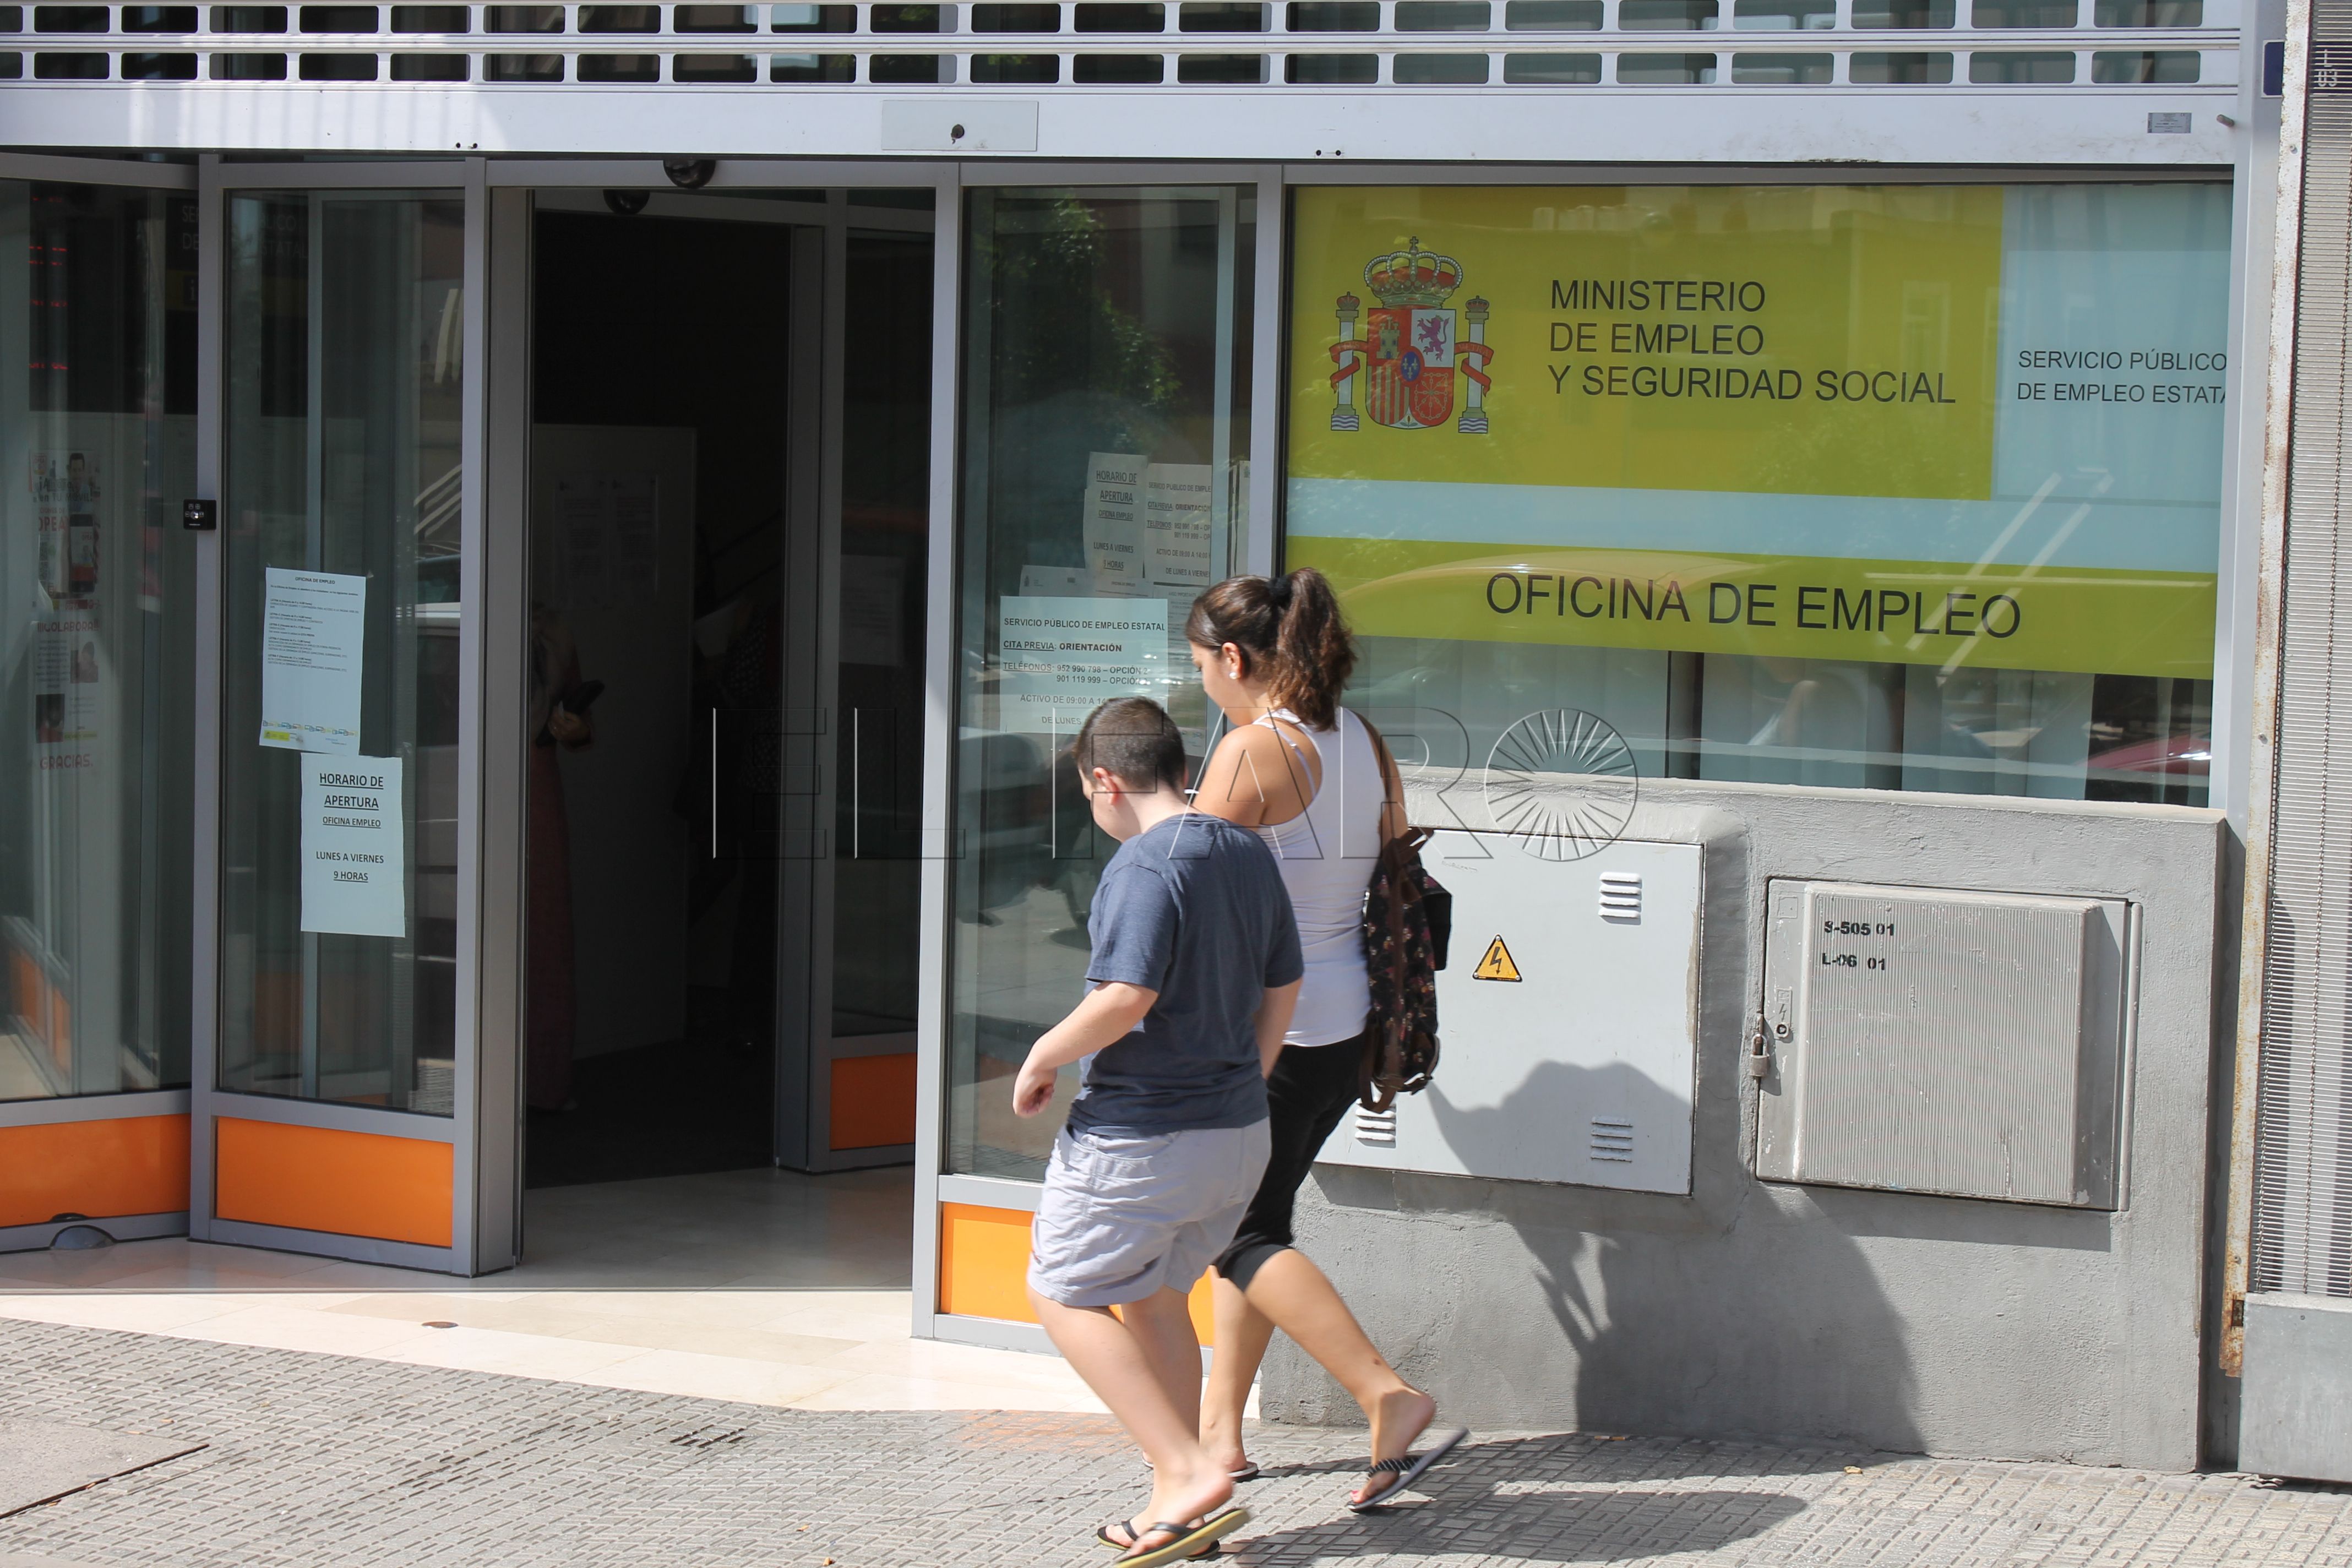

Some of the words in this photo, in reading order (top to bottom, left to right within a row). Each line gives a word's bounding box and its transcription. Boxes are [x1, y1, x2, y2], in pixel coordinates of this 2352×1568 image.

[1550, 280, 1766, 312] MINISTERIO
[1549, 322, 1597, 352] DE
[1611, 323, 1764, 356] EMPLEO
[2018, 350, 2122, 369] SERVICIO
[2130, 349, 2226, 371] PÚBLICO
[1548, 364, 1571, 394] Y
[1582, 365, 1803, 400] SEGURIDAD
[1815, 369, 1957, 404] SOCIAL
[2017, 383, 2046, 400] DE
[2054, 384, 2145, 402] EMPLEO
[2153, 385, 2225, 404] ESTAT
[1096, 470, 1127, 482] HORARIO
[1129, 473, 1137, 482] DE
[1100, 490, 1133, 503] APERTURA
[1098, 510, 1115, 519] OFICINA
[1116, 511, 1133, 520] EMPLEO
[1093, 542, 1109, 551] LUNES
[1115, 544, 1134, 553] VIERNES
[1107, 560, 1124, 569] HORAS
[1485, 572, 1691, 622] OFICINA
[1709, 582, 1777, 627] DE
[1796, 586, 2021, 639] EMPLEO
[1004, 618, 1042, 627] SERVICIO
[1044, 618, 1080, 628] PÚBLICO
[1095, 621, 1129, 630] EMPLEO
[1131, 622, 1165, 631] ESTATAL
[1004, 640, 1022, 649] CITA
[1025, 641, 1057, 650] PREVIA:
[1059, 642, 1122, 652] ORIENTACIÓN
[1003, 661, 1054, 672] TELÉFONOS:
[1109, 666, 1141, 674] OPCIÓN
[1057, 674, 1069, 683] 901
[1087, 676, 1101, 684] 999
[1020, 694, 1050, 703] ACTIVO
[1053, 695, 1064, 704] DE
[1066, 696, 1086, 704] 09:00
[1088, 696, 1095, 705] A
[1055, 717, 1082, 725] LUNES
[319, 772, 367, 787] HORARIO
[371, 776, 384, 787] DE
[324, 794, 379, 808] APERTURA
[323, 816, 350, 825] OFICINA
[352, 818, 381, 827] EMPLEO
[316, 851, 341, 861] LUNES
[351, 854, 384, 864] VIERNES
[333, 870, 338, 879] 9
[341, 871, 368, 881] HORAS
[1824, 921, 1871, 936] S-505
[1876, 923, 1894, 936] 01
[1867, 957, 1885, 971] 01
